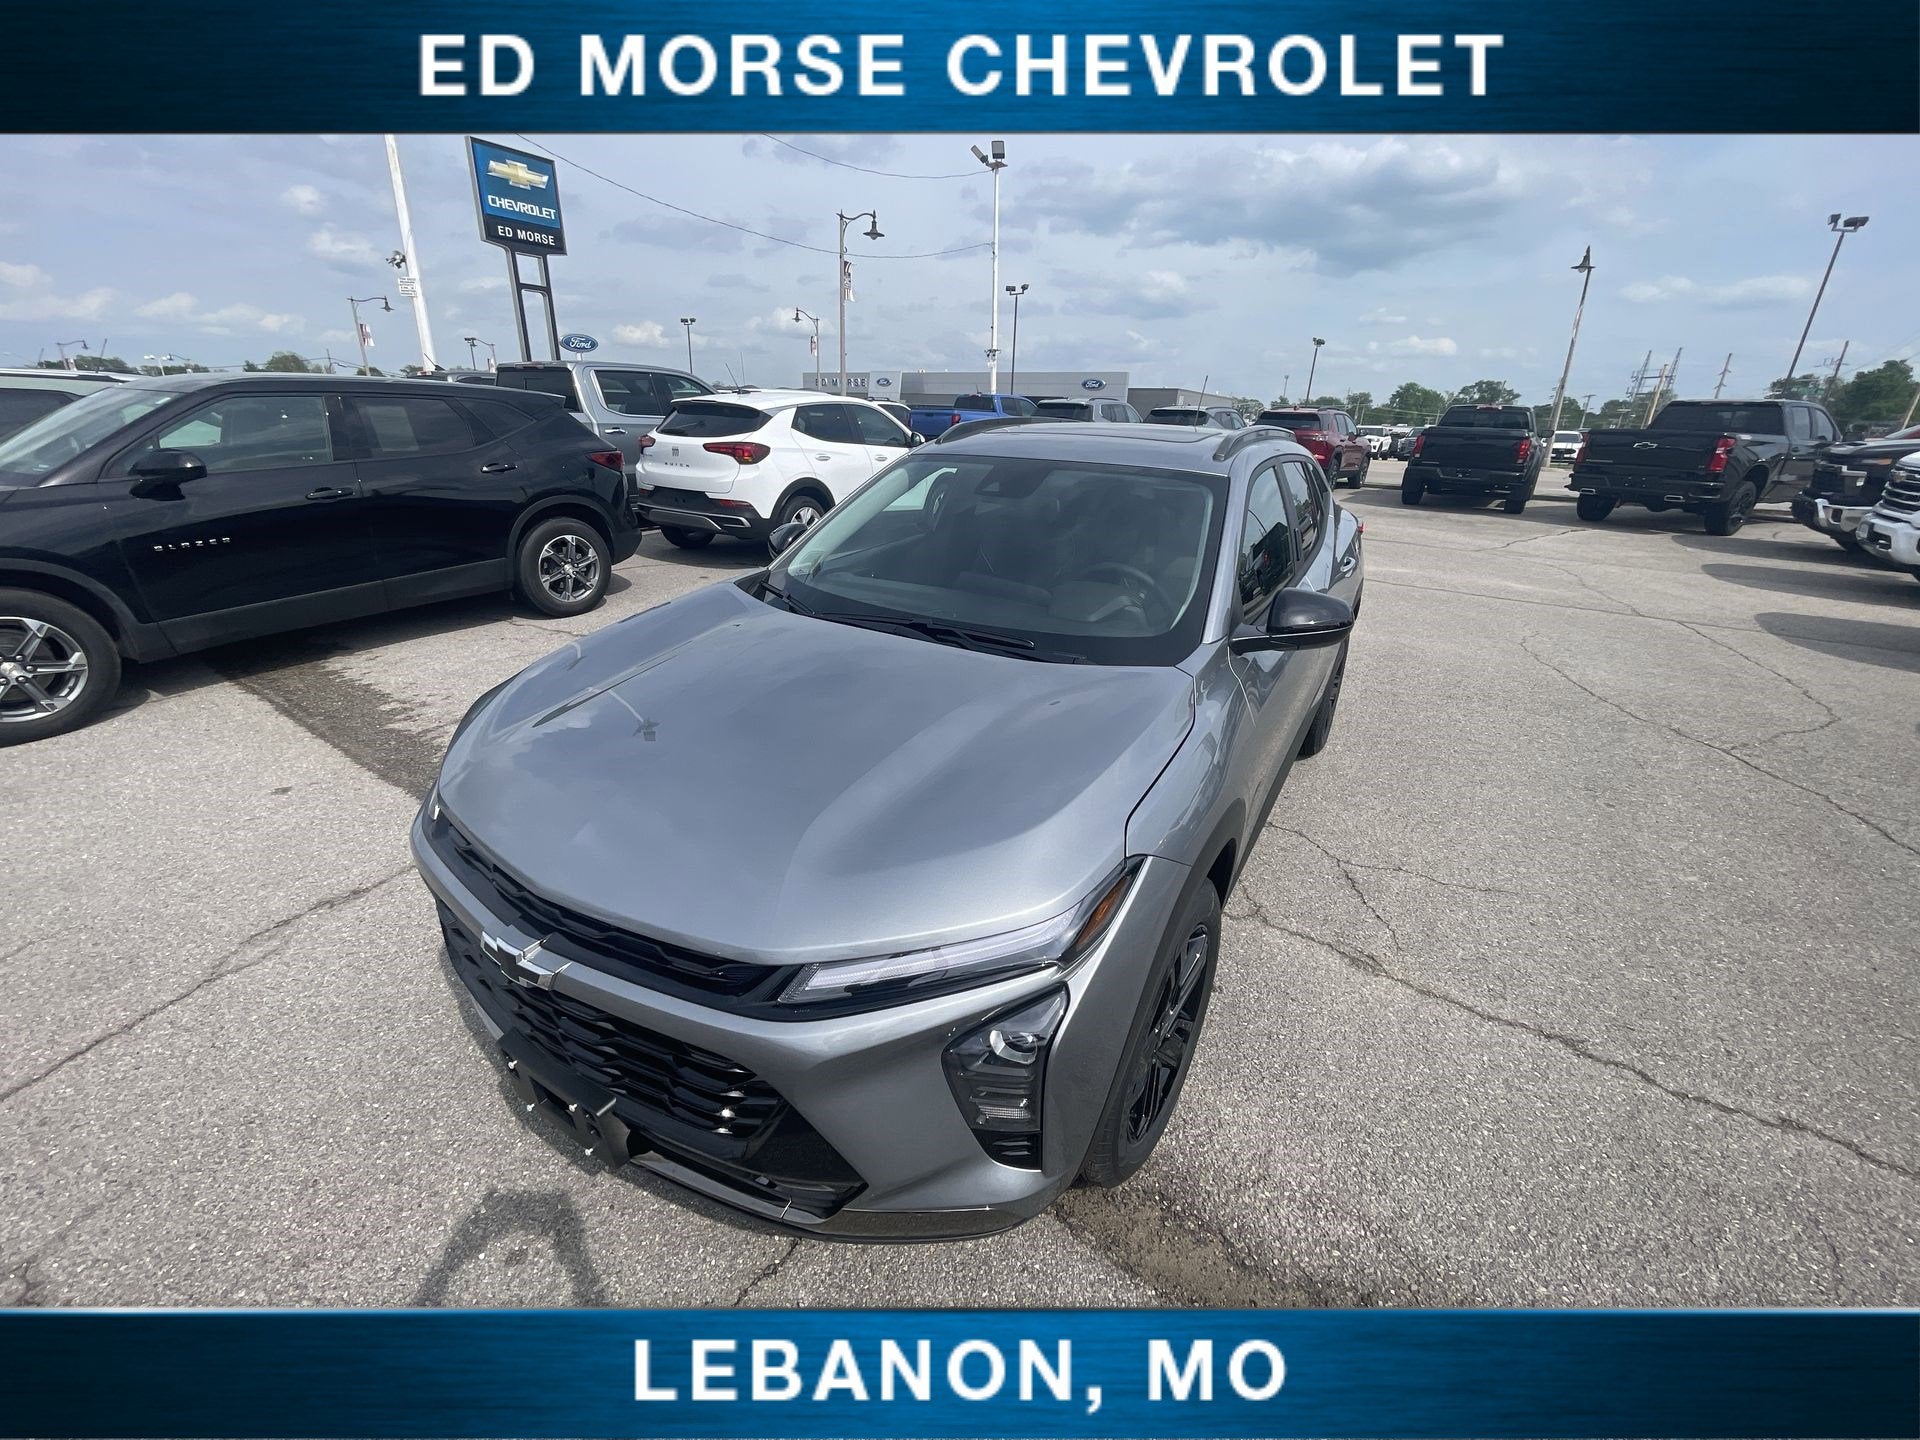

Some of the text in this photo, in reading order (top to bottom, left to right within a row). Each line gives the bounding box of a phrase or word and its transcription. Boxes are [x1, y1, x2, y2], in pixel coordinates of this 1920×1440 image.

[487, 194, 556, 220] CHEVROLET
[497, 225, 556, 246] ED MORSE
[570, 336, 592, 349] Ford
[832, 378, 866, 387] MRSE
